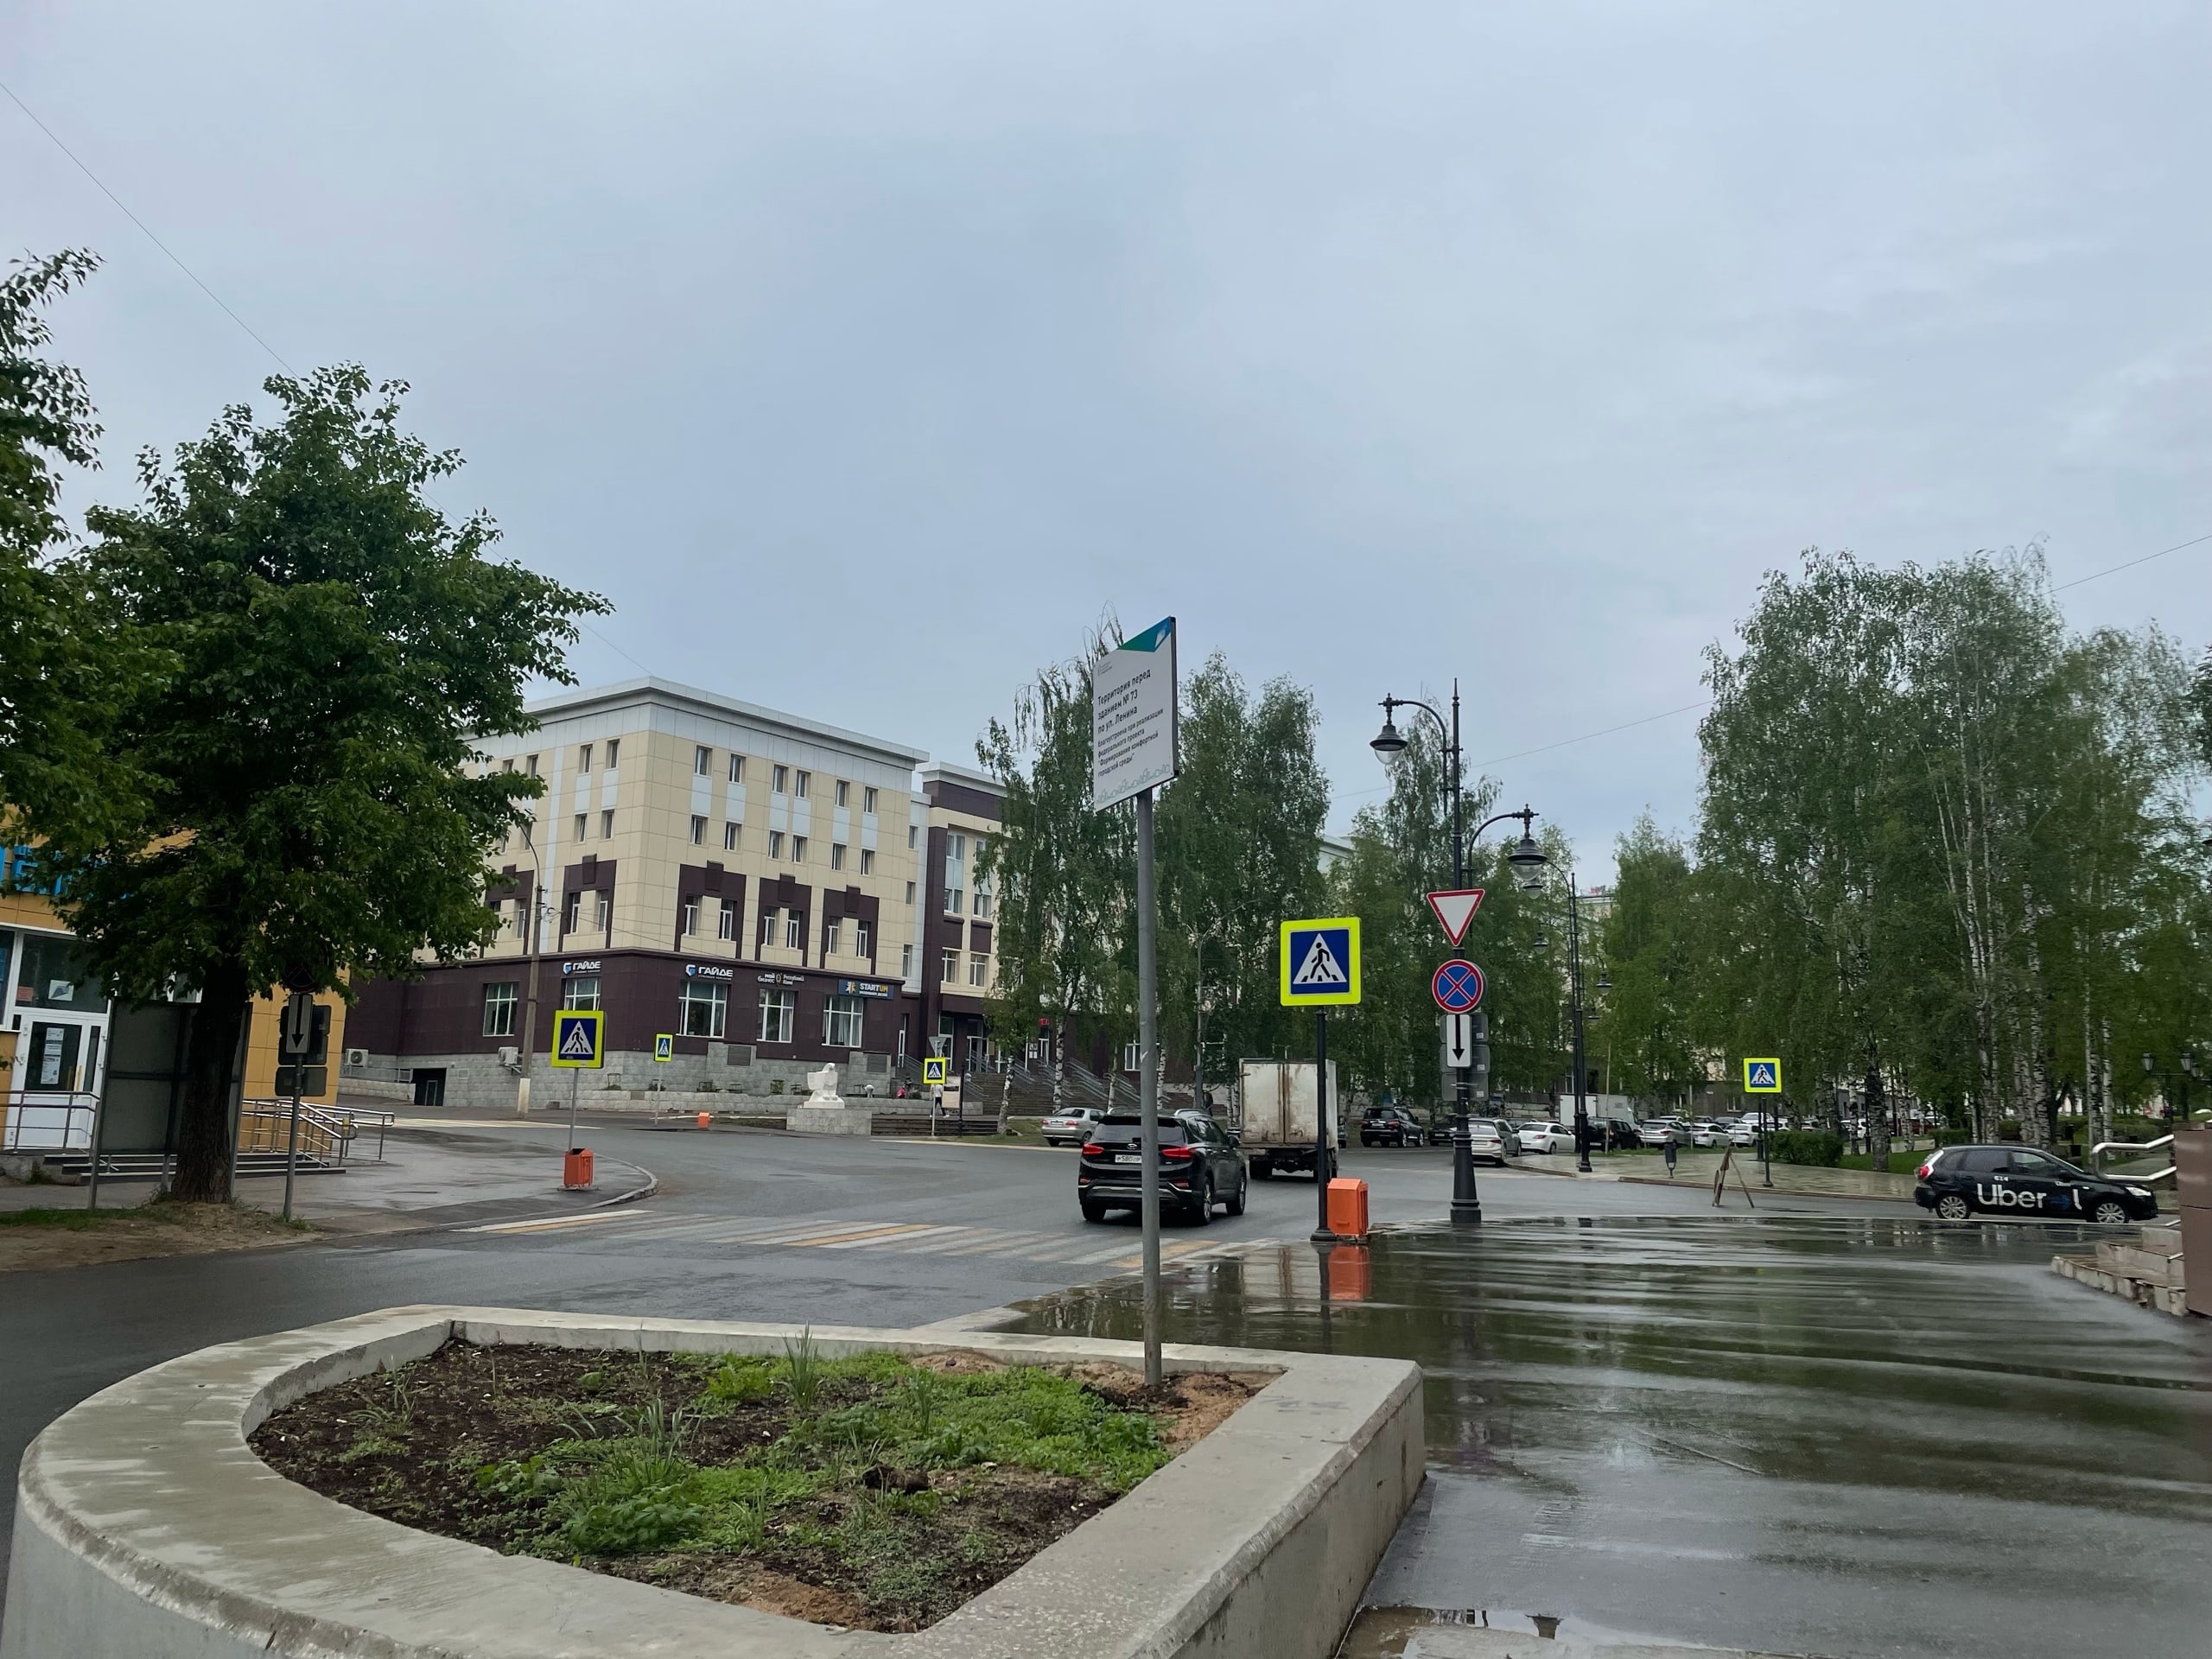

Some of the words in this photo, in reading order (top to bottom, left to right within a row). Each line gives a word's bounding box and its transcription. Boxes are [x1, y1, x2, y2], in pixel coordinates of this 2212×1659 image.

[1097, 681, 1130, 706] Территория
[1131, 669, 1151, 685] перед
[1097, 701, 1122, 721] зданием
[1130, 689, 1138, 701] 73
[1097, 724, 1105, 734] по
[1115, 706, 1138, 724] Ленина
[1136, 709, 1164, 728] реализации
[1097, 738, 1127, 759] федерального
[1127, 728, 1145, 742] проекта
[1131, 730, 1159, 749] комфортной
[1097, 761, 1119, 777] городской
[573, 960, 601, 970] ГАЙДЕ
[698, 966, 734, 977] ГАЙДЕ
[1976, 1183, 2047, 1209] Uber
